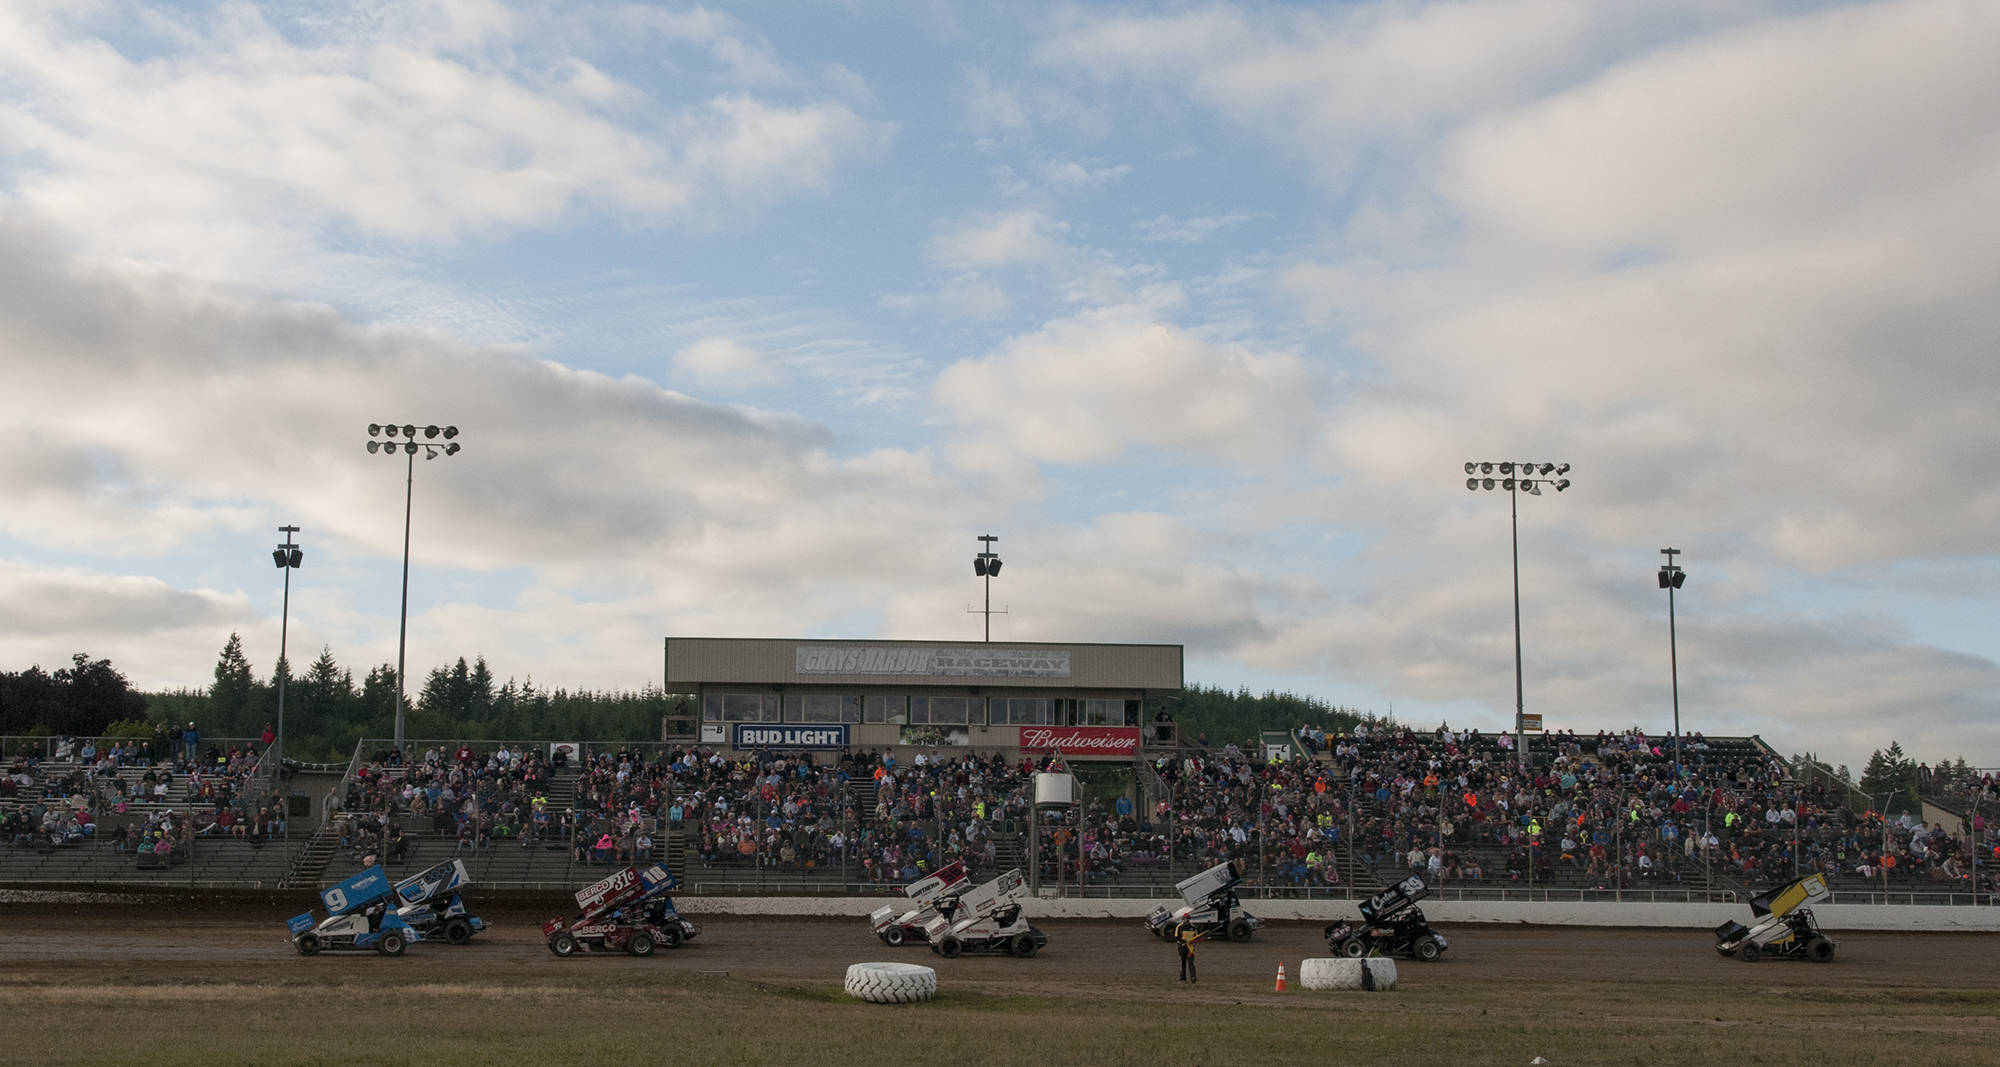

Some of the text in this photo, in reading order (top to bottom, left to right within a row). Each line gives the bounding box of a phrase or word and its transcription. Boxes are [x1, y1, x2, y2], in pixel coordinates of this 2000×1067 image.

[804, 649, 860, 671] GRAYS
[861, 648, 931, 672] HARBOR
[936, 657, 1065, 669] RACEWAY
[743, 730, 841, 744] BUD LIGHT
[1023, 729, 1135, 748] Budweiser
[577, 880, 610, 902] BERCO
[1801, 877, 1826, 897] 5
[325, 888, 348, 912] 9
[582, 923, 617, 935] BERCO
